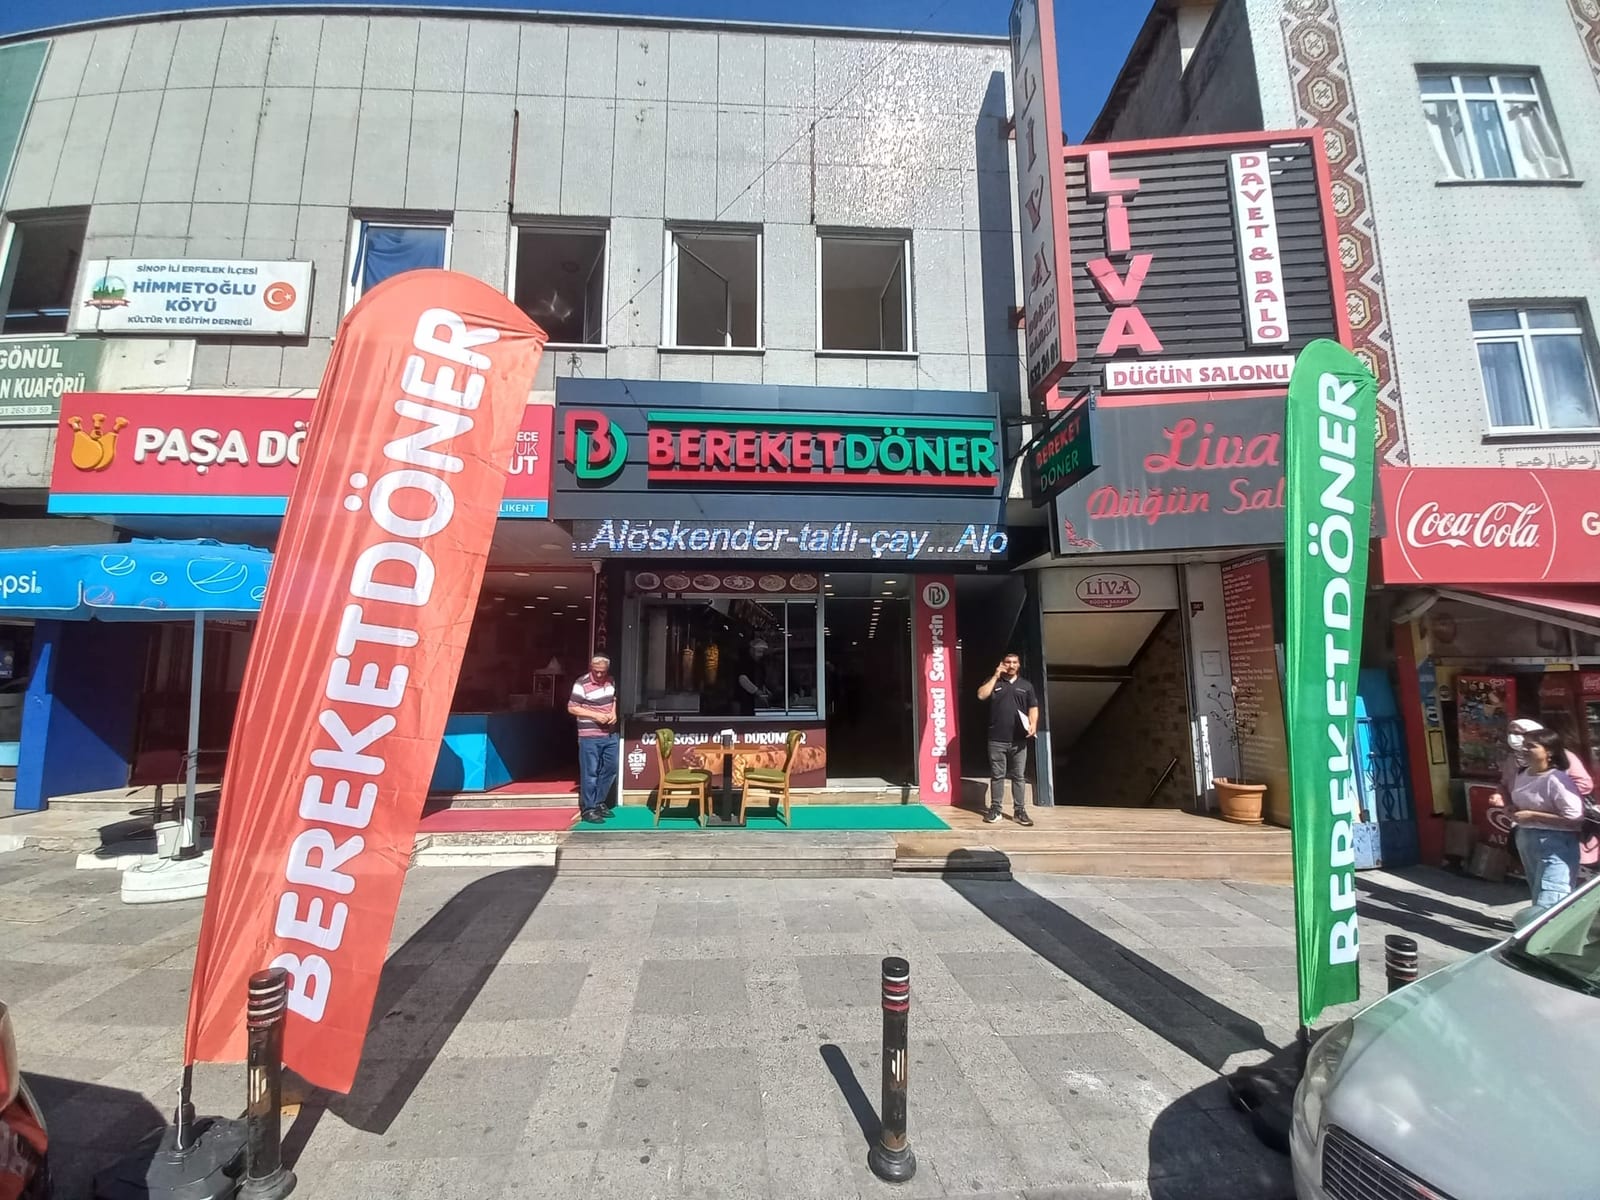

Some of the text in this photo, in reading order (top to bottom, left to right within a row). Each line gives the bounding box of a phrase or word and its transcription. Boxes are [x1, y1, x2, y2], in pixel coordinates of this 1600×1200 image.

[1239, 155, 1282, 339] DAVET & BALO
[136, 263, 258, 276] SİNOP İLİ ERFELEK İLÇESİ
[132, 278, 257, 297] HİMMETOĞLU
[165, 297, 217, 313] KÖYÜ
[127, 314, 252, 327] KÜLTÜR VE EĞİTİM DERNEĞİ
[0, 344, 63, 370] GÖNÜL
[13, 372, 86, 399] KUAFÖRÜ
[1113, 363, 1290, 387] DÜĞÜN SALONU
[133, 427, 249, 475] PAŞA
[1036, 415, 1080, 469] BEREKET
[1143, 417, 1281, 474] Liva
[1086, 484, 1210, 526] Düğün
[1406, 502, 1545, 548] Coca-Cola
[0, 570, 37, 599] psi
[1085, 578, 1133, 595] LİVA
[928, 614, 945, 682] Seversin
[265, 307, 502, 1024] BEREKETDÖNER
[1307, 372, 1360, 966] BEREKETDÖNER
[628, 752, 647, 763] SEN
[932, 763, 949, 793] Sen
